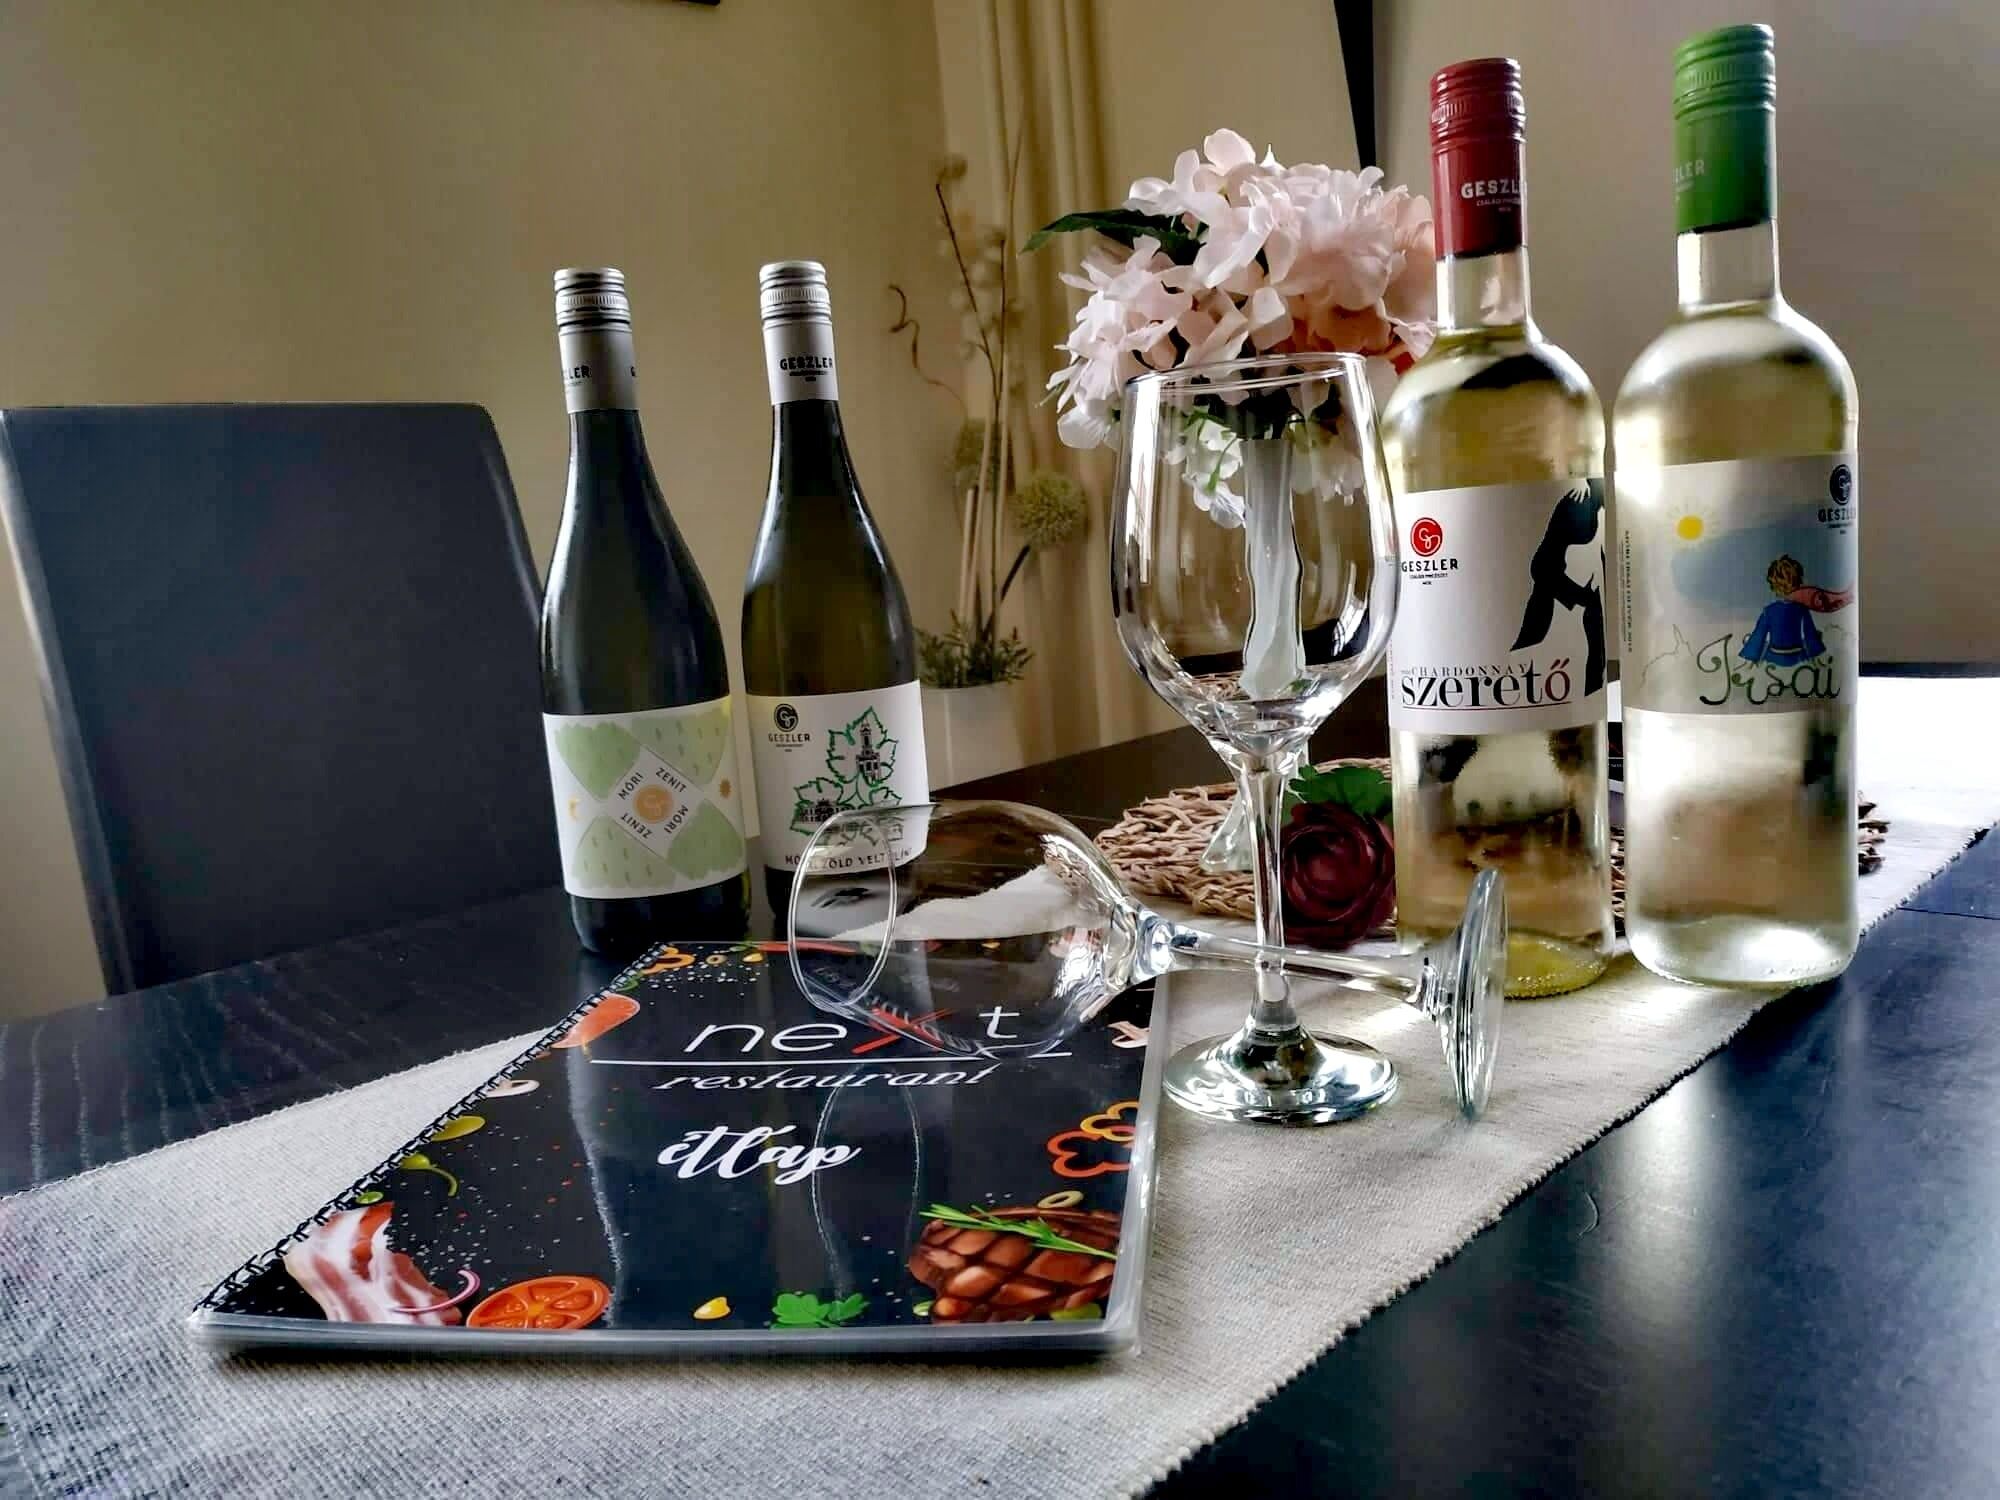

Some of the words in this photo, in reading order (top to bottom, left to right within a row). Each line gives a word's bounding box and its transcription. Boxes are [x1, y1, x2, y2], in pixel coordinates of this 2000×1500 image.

[1401, 558, 1458, 573] GESZLER
[1401, 658, 1571, 708] szerető
[1412, 663, 1528, 677] CHARDONNAY
[768, 733, 810, 743] GESZLER
[655, 767, 687, 793] ZENIT
[621, 812, 653, 839] ZENIT
[651, 1063, 1003, 1090] restaurant
